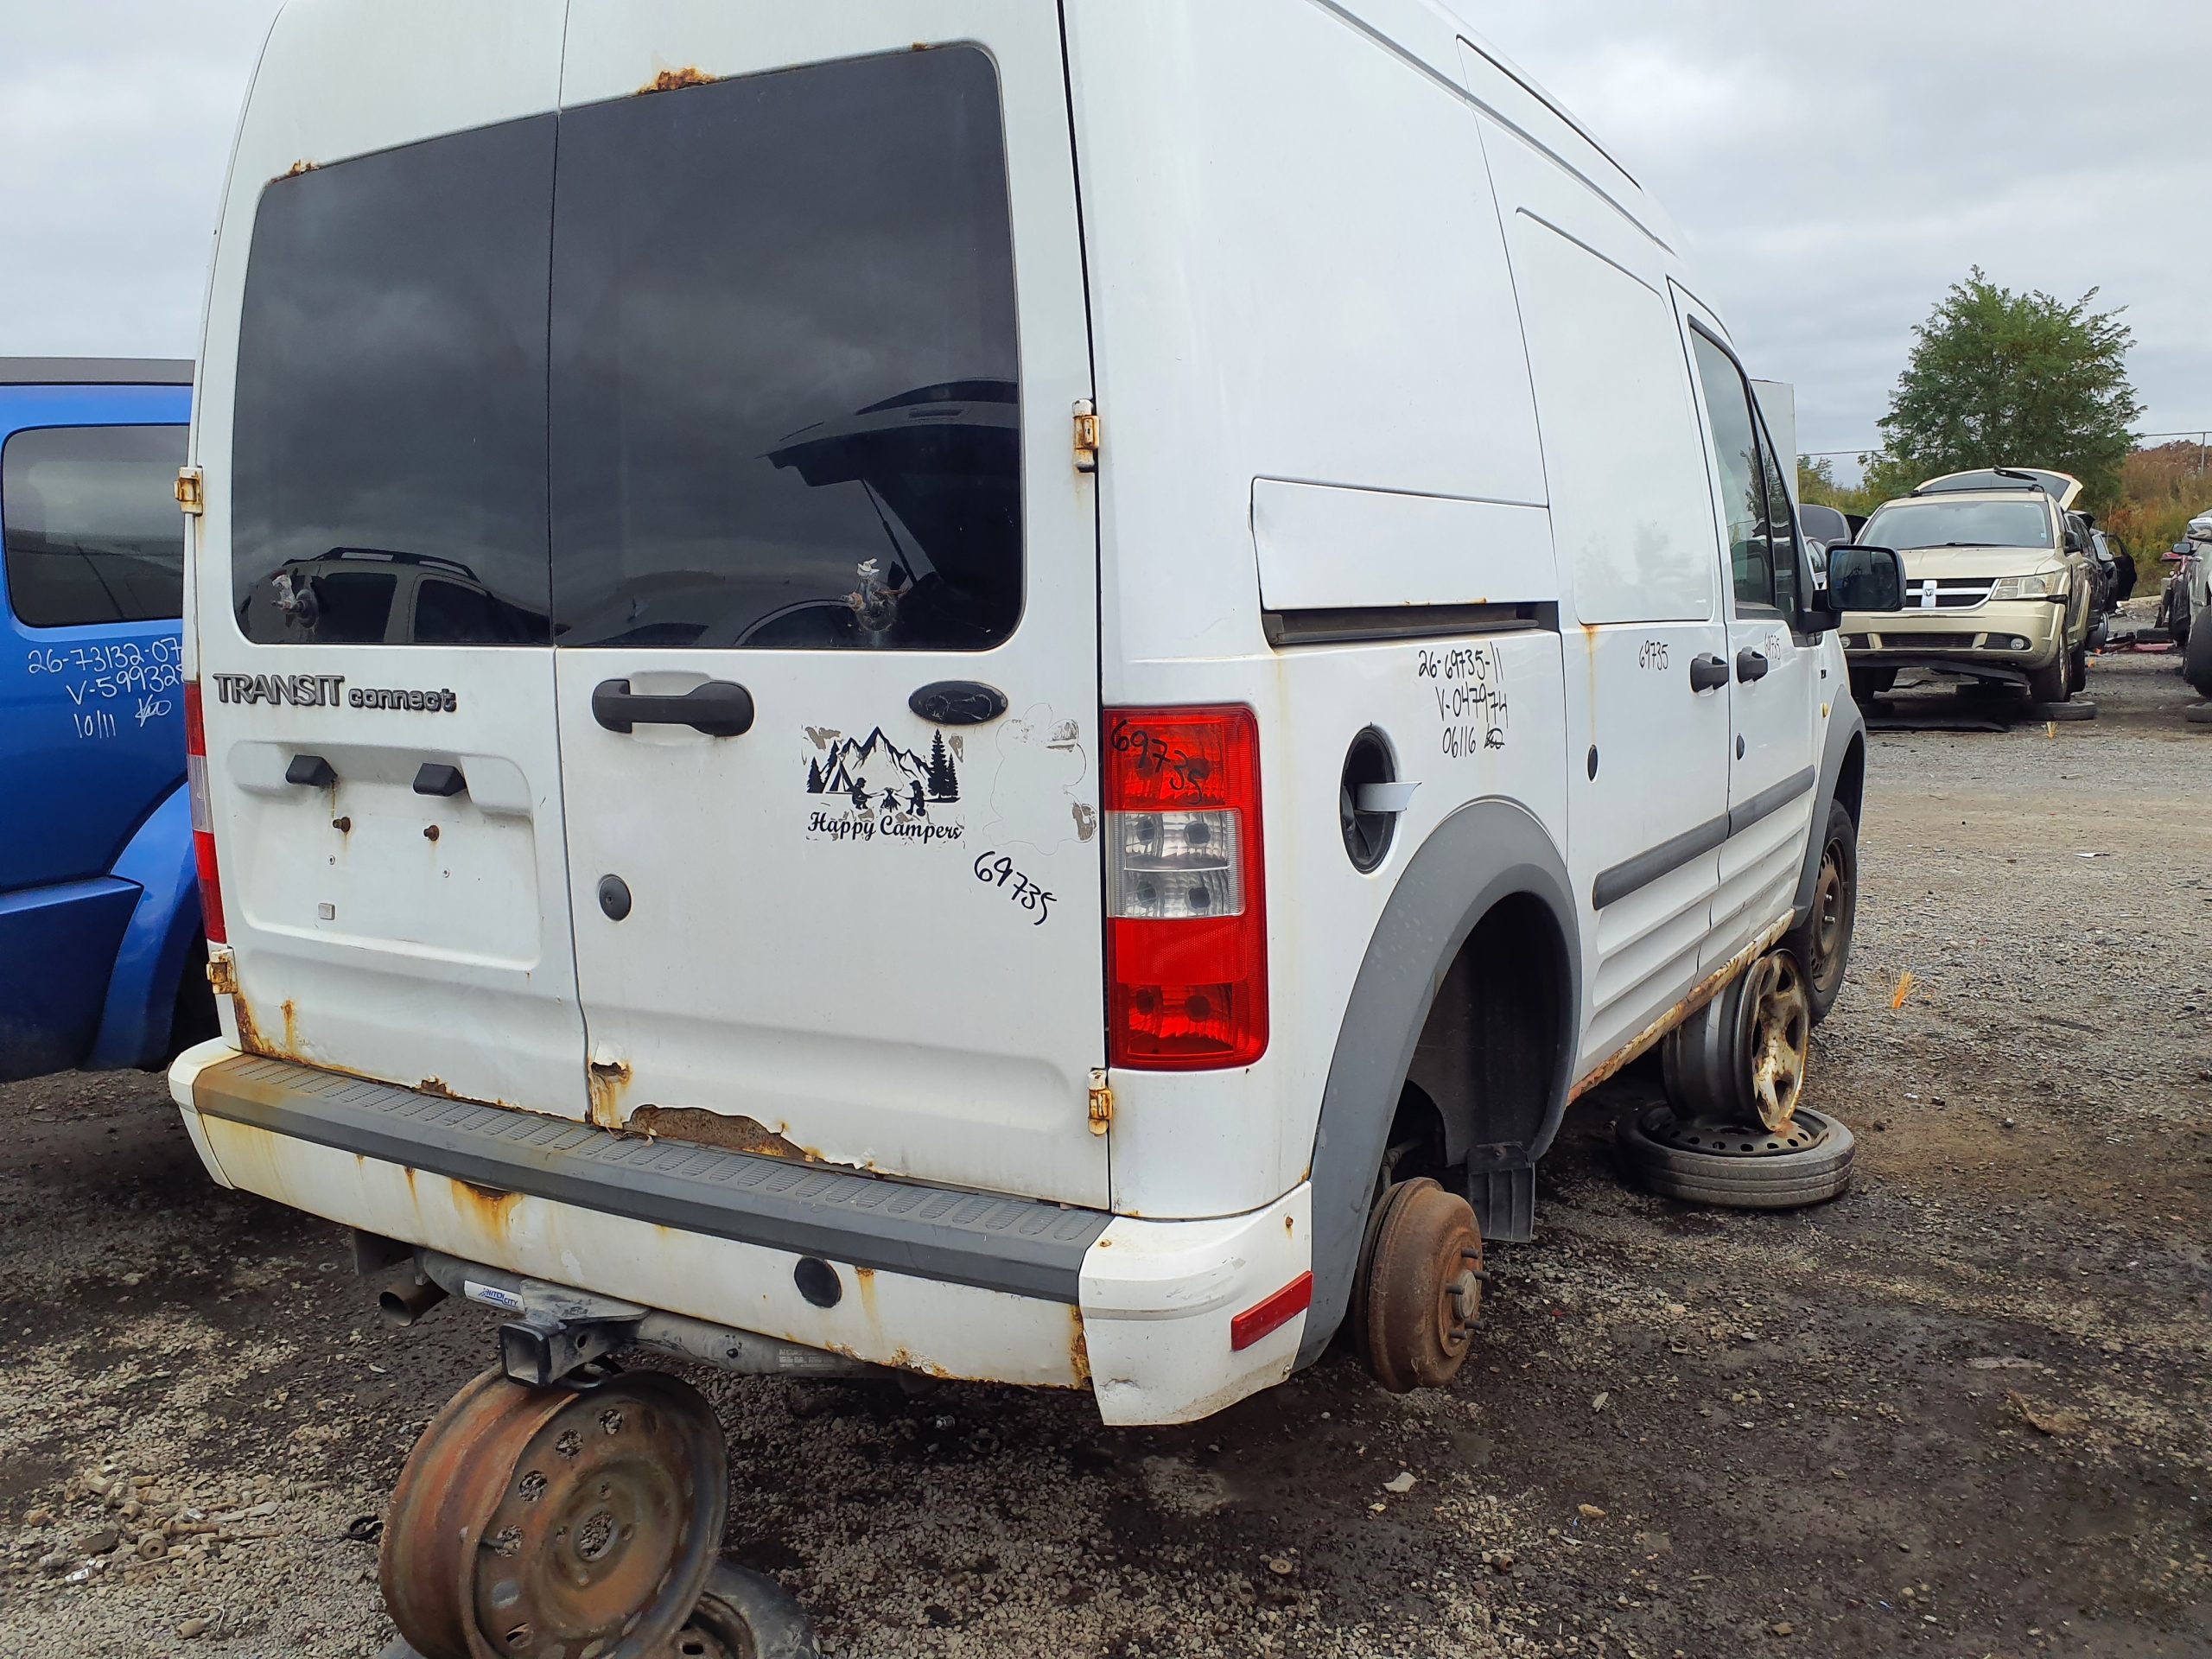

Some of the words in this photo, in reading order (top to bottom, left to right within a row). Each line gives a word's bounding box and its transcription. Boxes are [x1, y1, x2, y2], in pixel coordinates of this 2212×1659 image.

[28, 637, 183, 674] 26-73132-07
[1638, 639, 1669, 671] 69735
[213, 672, 345, 707] TRANSIT
[348, 688, 457, 712] connect
[1110, 719, 1205, 805] 69735
[807, 811, 876, 841] Happy
[880, 815, 963, 844] Campers
[504, 1297, 518, 1306] CITY
